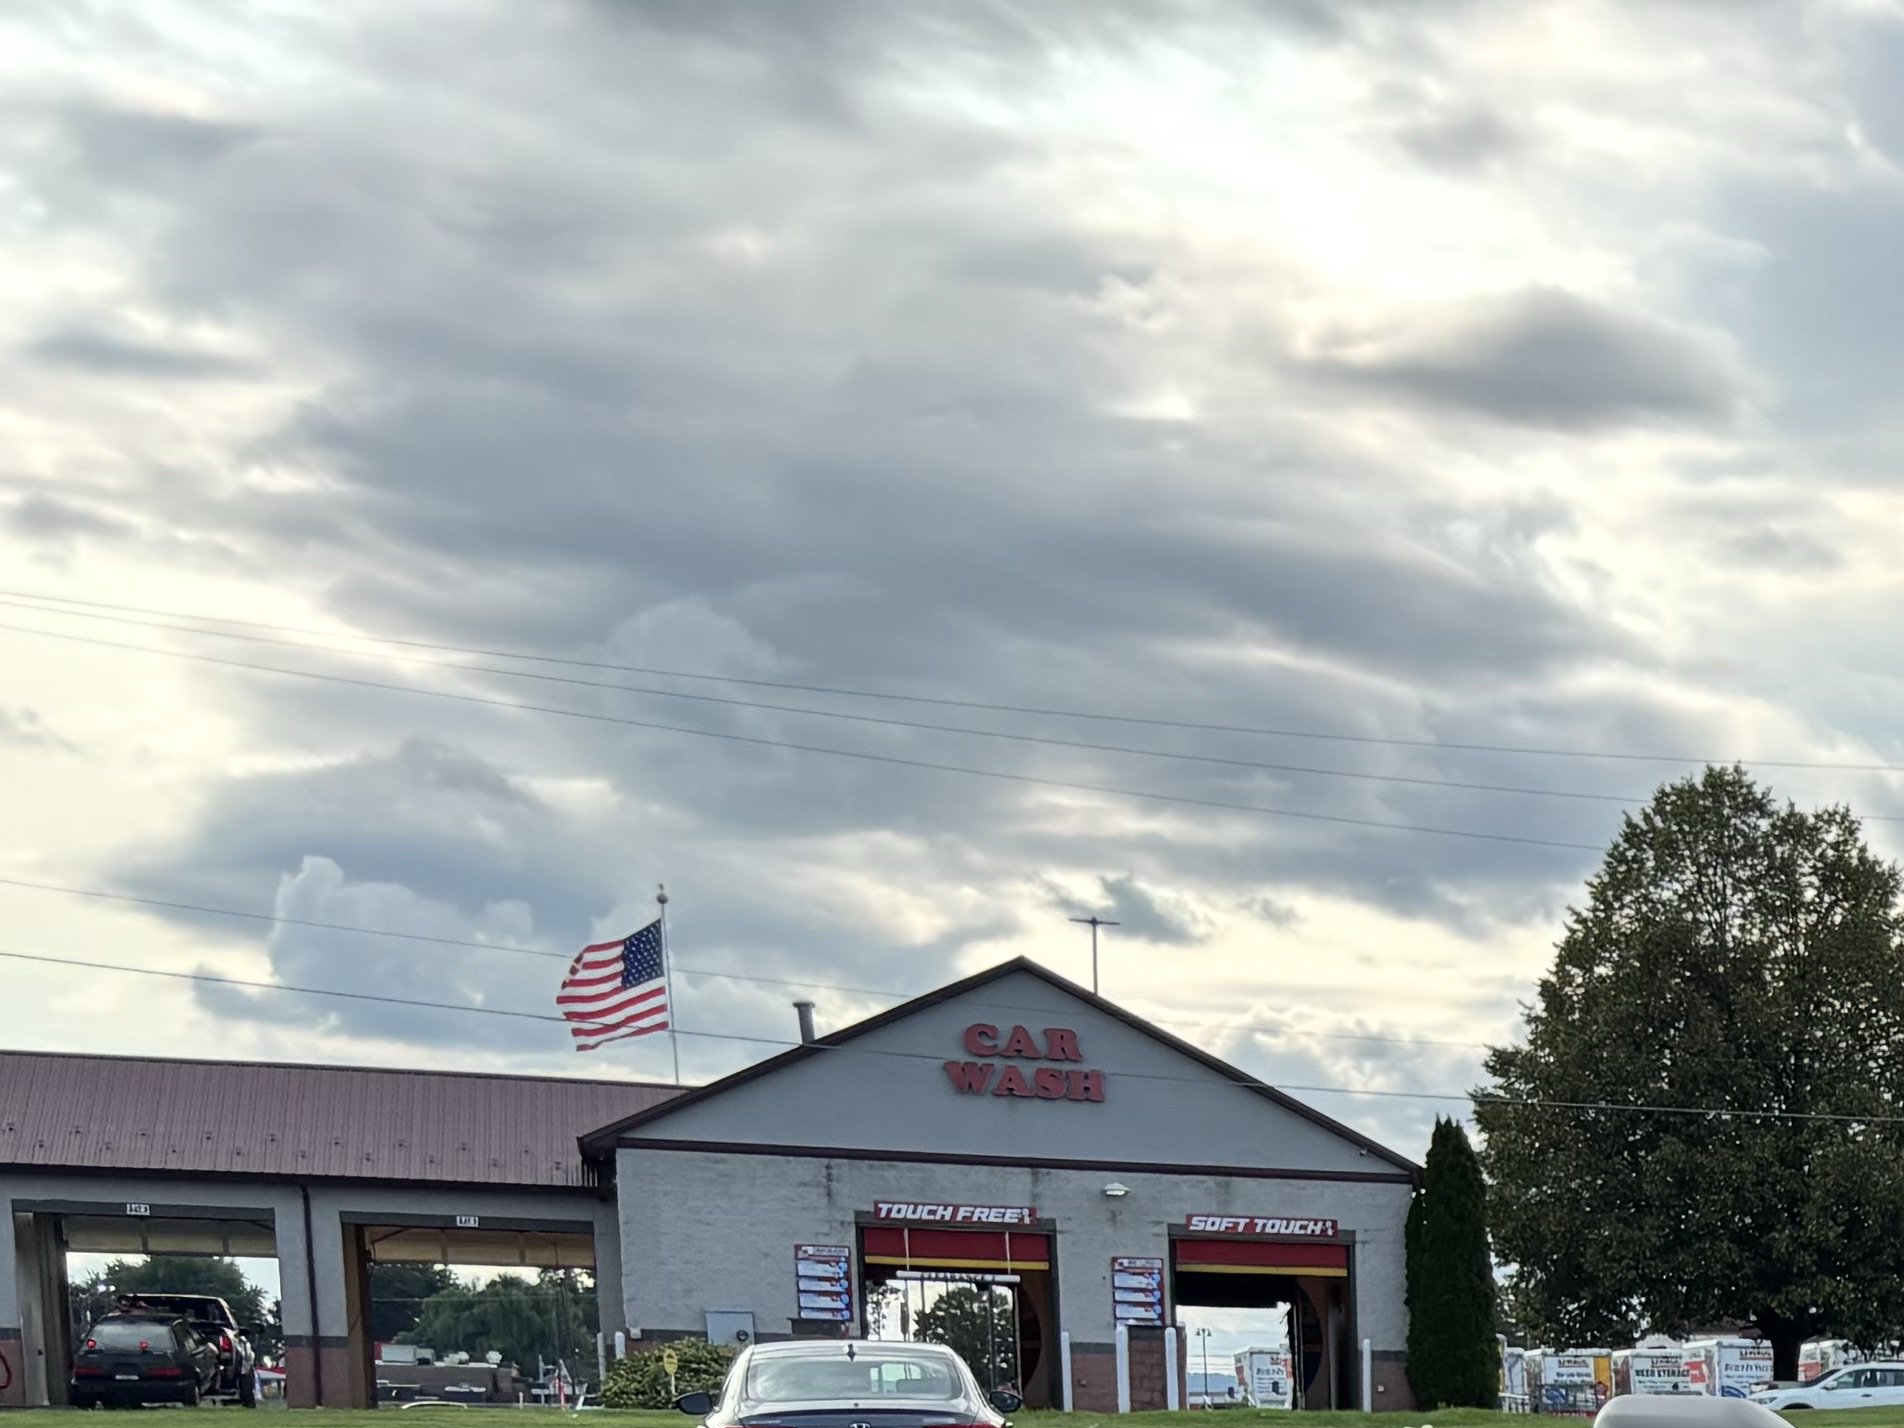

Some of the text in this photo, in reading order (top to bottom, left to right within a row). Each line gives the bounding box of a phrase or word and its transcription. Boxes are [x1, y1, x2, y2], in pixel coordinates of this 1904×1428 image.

[963, 1022, 1084, 1063] CAR
[943, 1061, 1106, 1103] WASH
[877, 1203, 954, 1221] TOUCH
[1189, 1216, 1324, 1236] SOFT TOUCH
